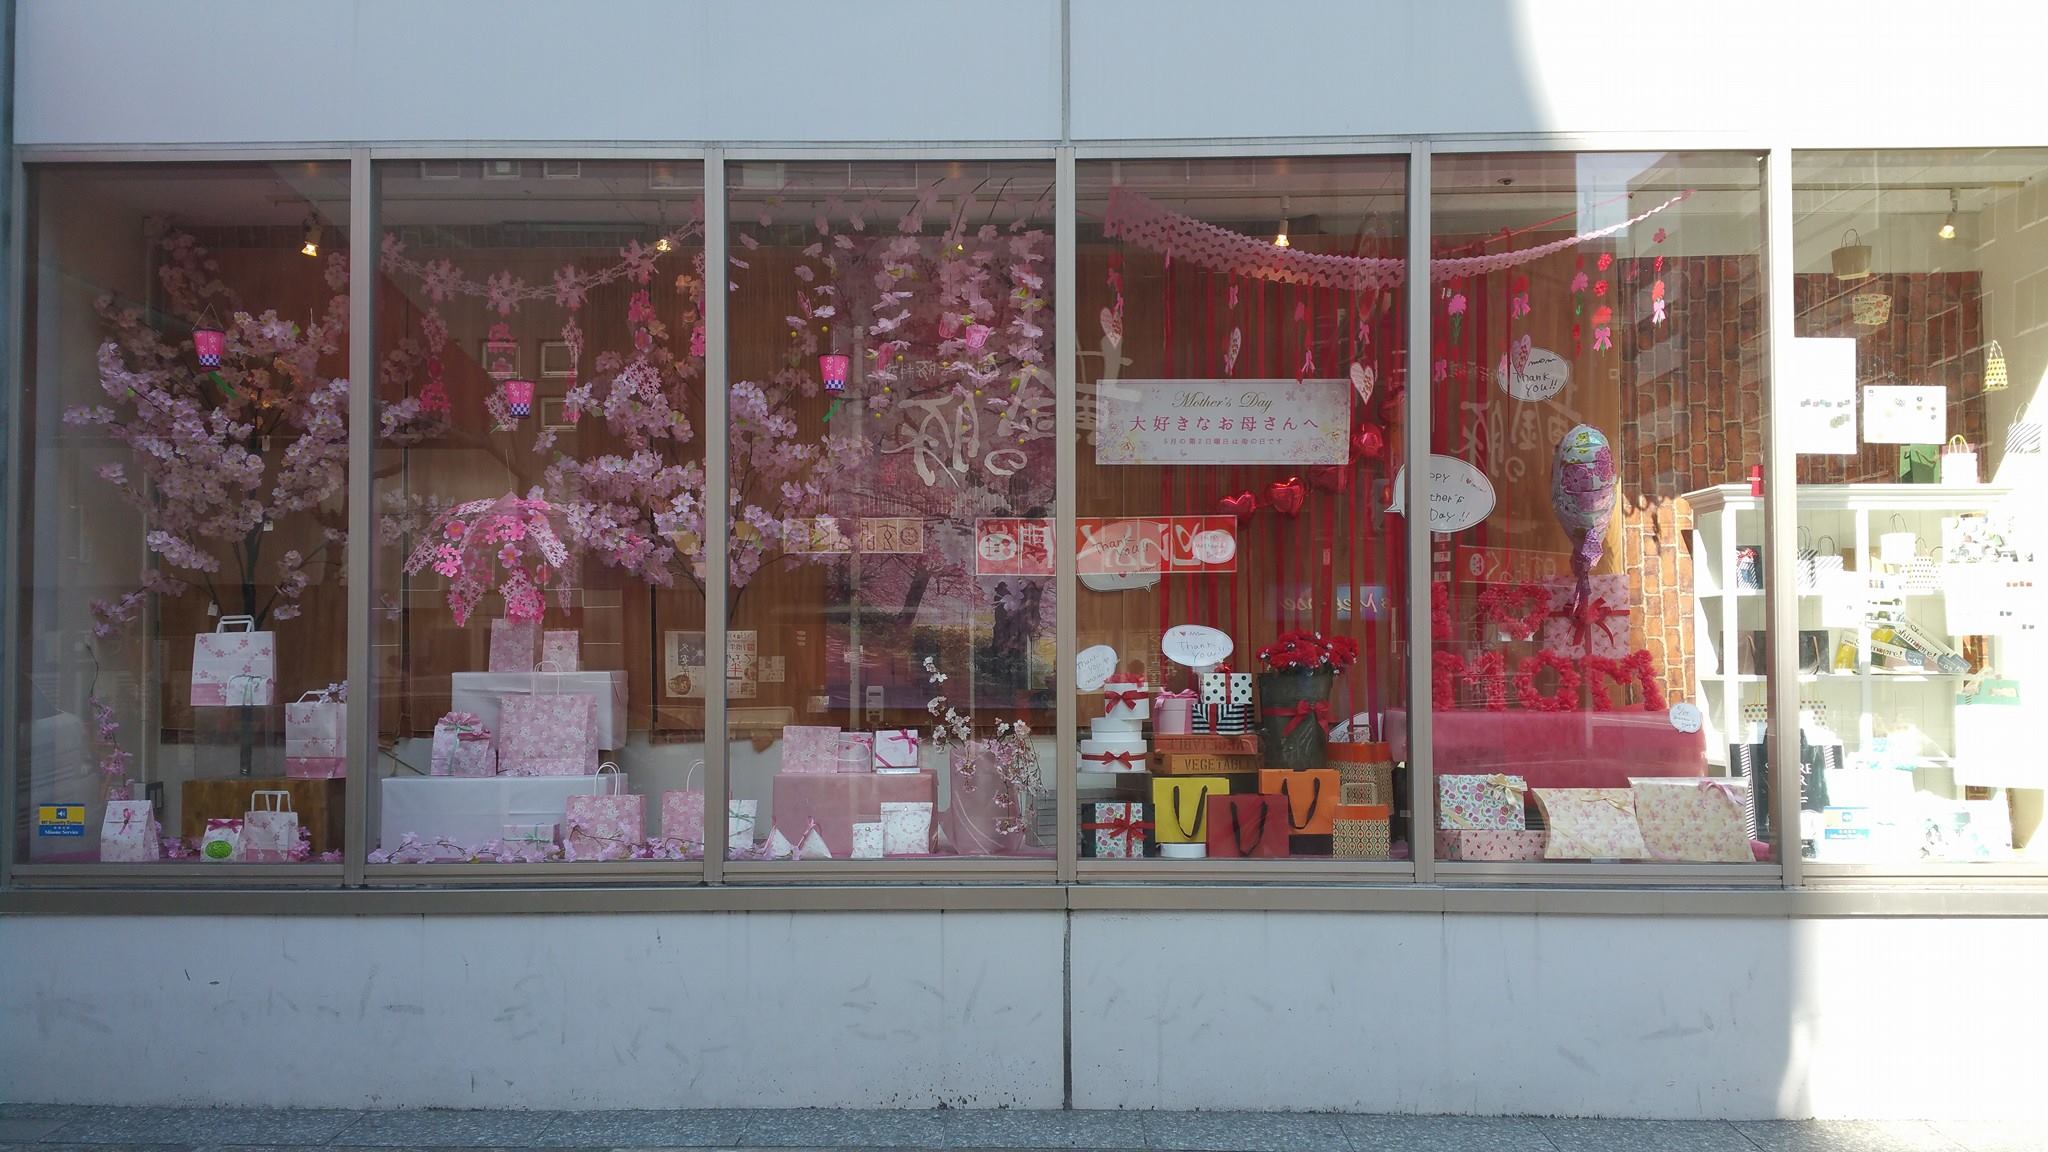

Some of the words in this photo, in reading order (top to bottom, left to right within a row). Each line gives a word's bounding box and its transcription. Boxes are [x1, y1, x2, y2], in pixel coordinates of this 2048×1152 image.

[1171, 391, 1232, 409] Mother's
[1239, 391, 1273, 415] Day
[1129, 415, 1318, 432] 大好きなお母さんへ
